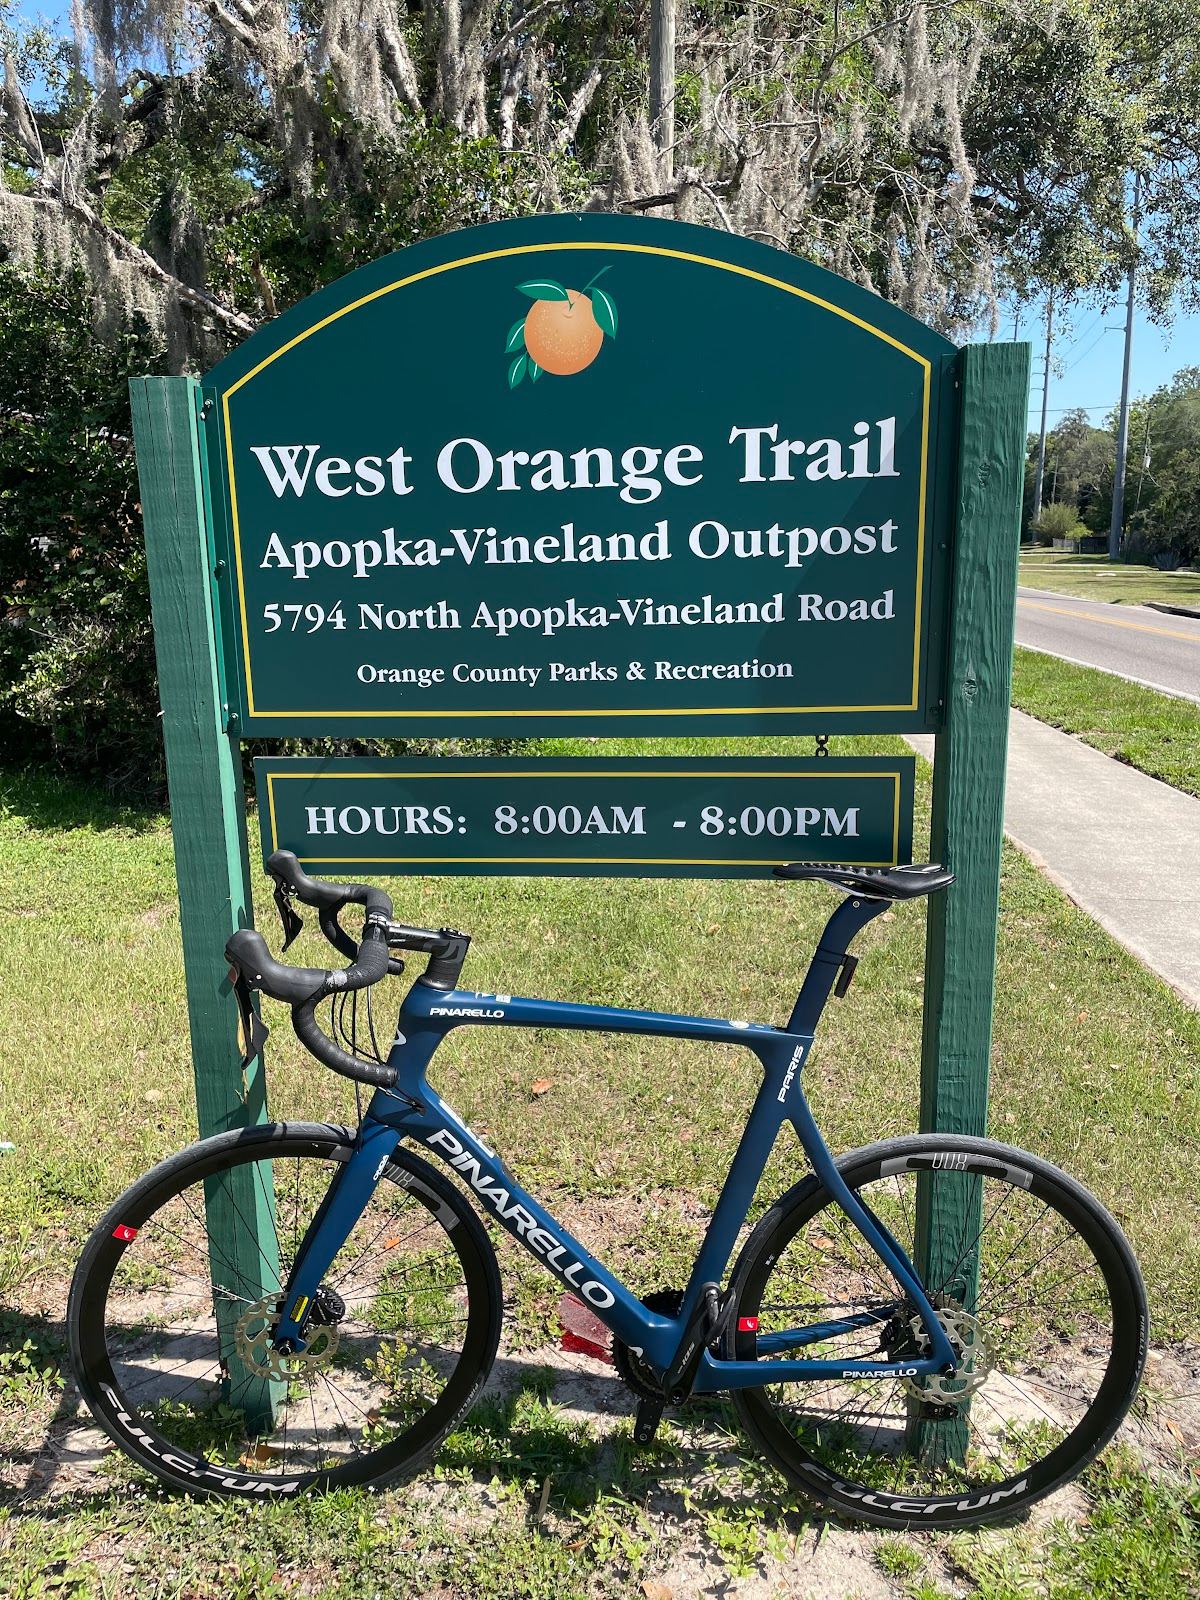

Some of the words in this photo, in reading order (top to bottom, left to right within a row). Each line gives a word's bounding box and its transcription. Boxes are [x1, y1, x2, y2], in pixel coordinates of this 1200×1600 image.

[250, 444, 414, 498] West
[437, 437, 704, 505] Orange
[728, 416, 901, 483] Trail
[260, 519, 672, 579] Apopka-Vineland
[688, 518, 898, 568] Outpost
[263, 600, 347, 634] 5794
[358, 600, 461, 631] North
[471, 592, 786, 637] Apopka-Vineland
[797, 589, 896, 622] Road
[356, 664, 445, 688] Orange
[452, 663, 543, 688] County
[549, 660, 618, 682] Parks
[625, 661, 647, 681] &
[655, 658, 794, 680] Recreation
[305, 805, 467, 835] HOURS:
[494, 805, 647, 835] 8:00AM
[699, 805, 860, 837] 8:00PM
[429, 1007, 505, 1019] PINARELLO
[777, 1045, 804, 1103] PARIS
[426, 1128, 616, 1309] PINARELLO
[842, 1367, 918, 1380] PINARELLO
[98, 1381, 300, 1494] FULCRUM
[800, 1461, 1029, 1515] FULCRUM
